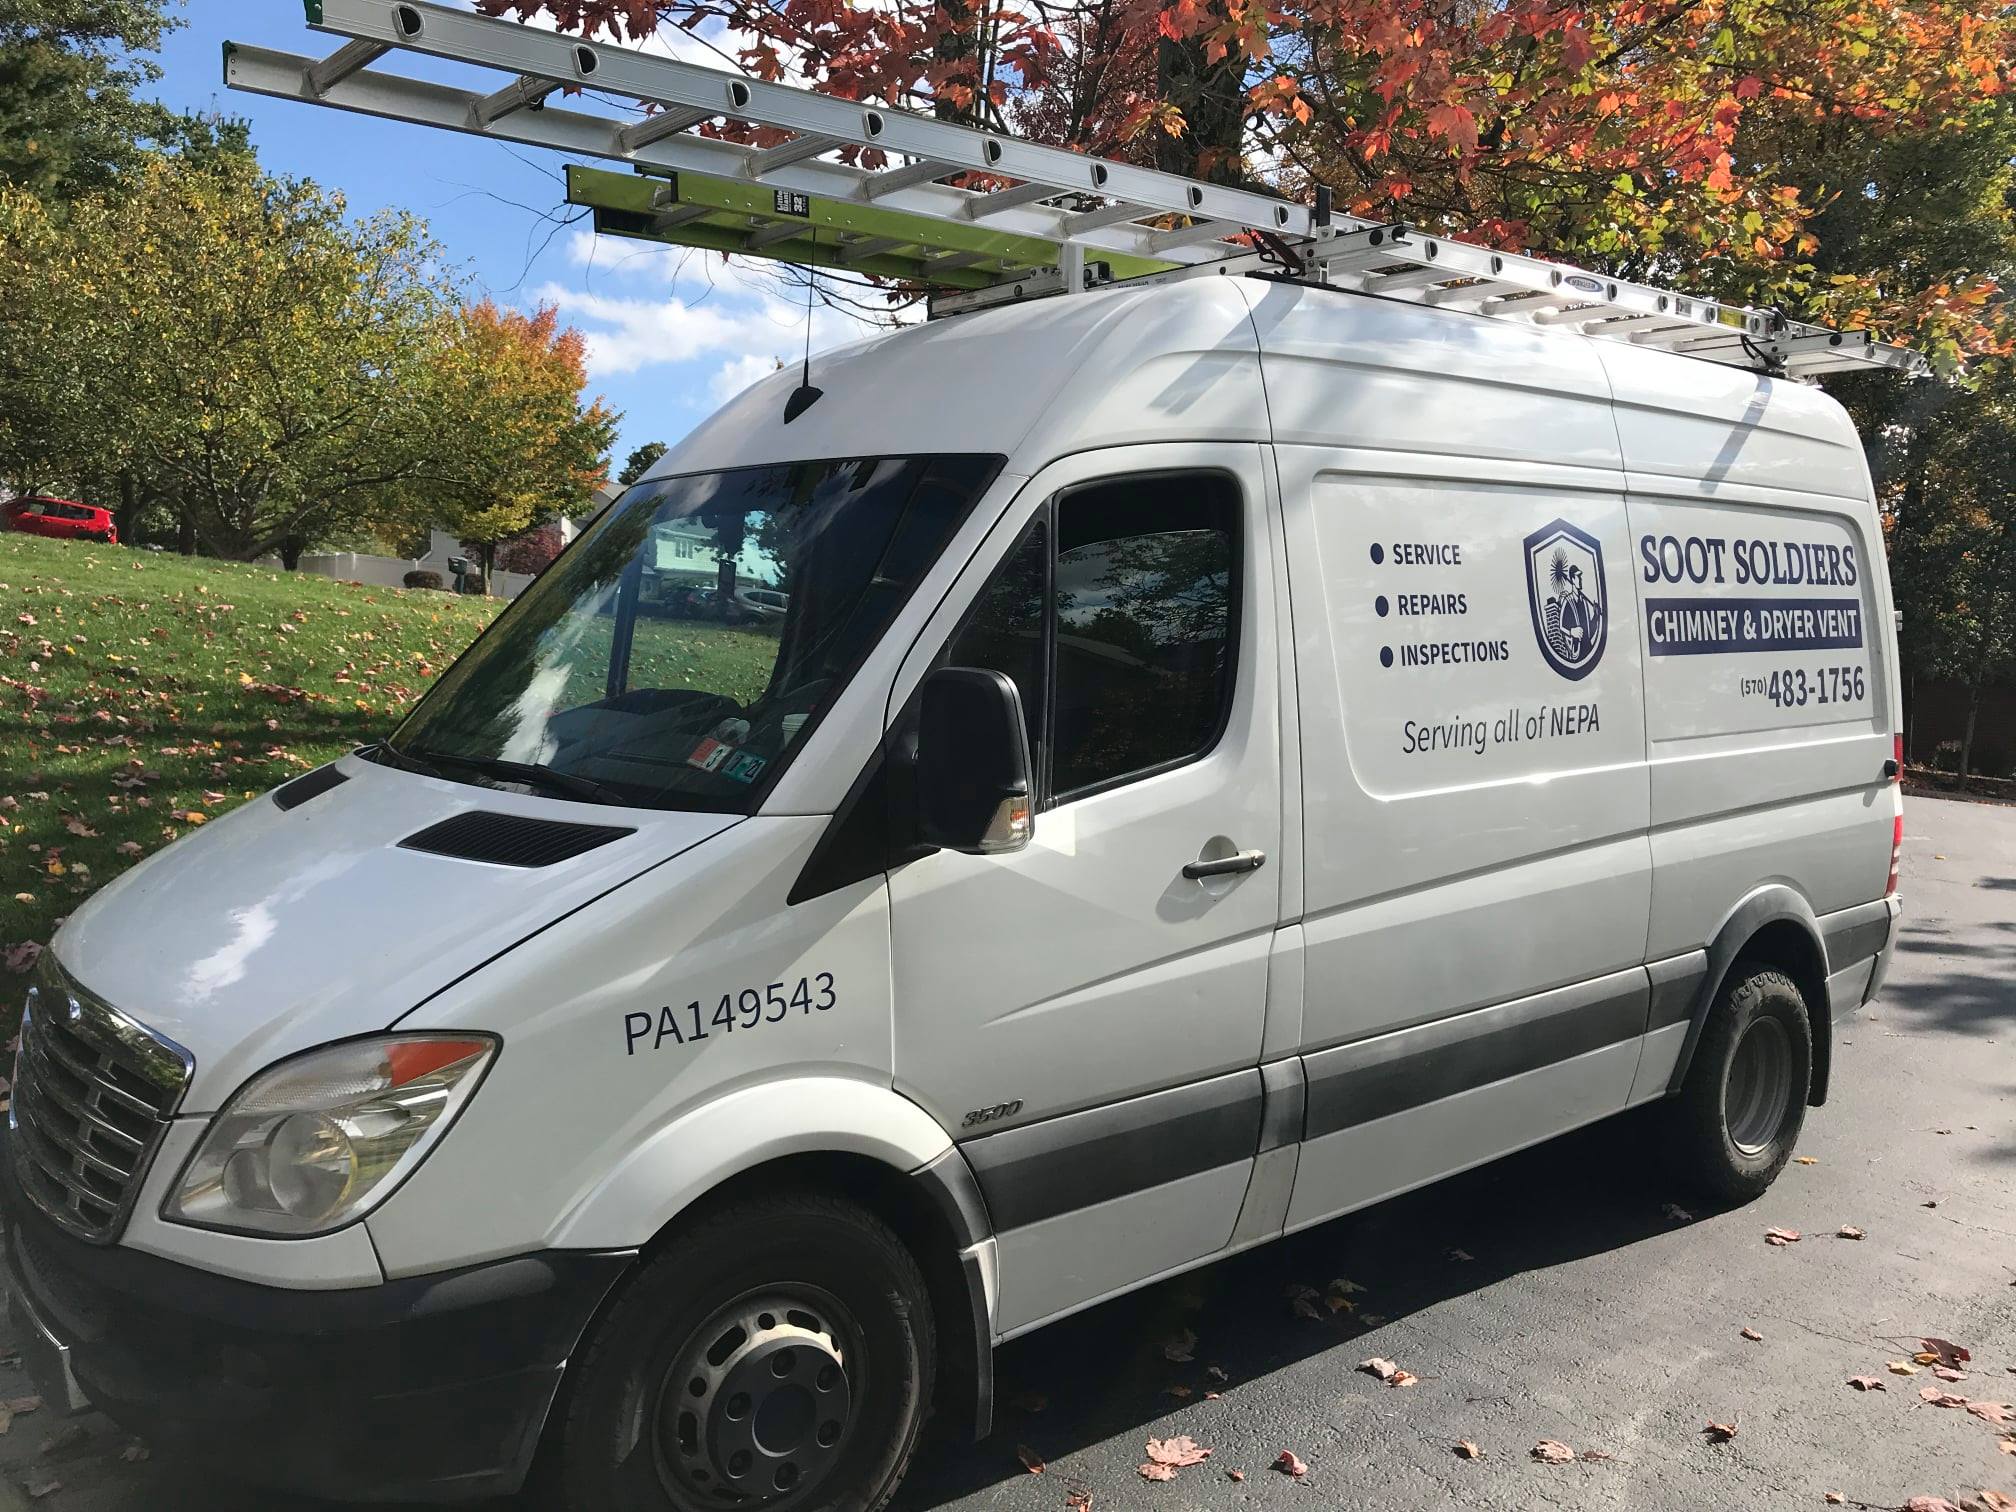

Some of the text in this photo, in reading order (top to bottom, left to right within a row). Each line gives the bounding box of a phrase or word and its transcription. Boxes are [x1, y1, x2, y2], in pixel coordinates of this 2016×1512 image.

[1393, 543, 1461, 565] SERVICE
[1641, 535, 1857, 586] SOOT SOLDIERS
[1398, 594, 1467, 616] REPAIRS
[1651, 609, 1857, 643] CHIMNEY & DRYER VENT
[1401, 640, 1509, 666] INSPECTIONS
[1403, 703, 1600, 755] Serving all of NEPA
[624, 972, 837, 1056] PA149543
[961, 1099, 1024, 1128] 3500
